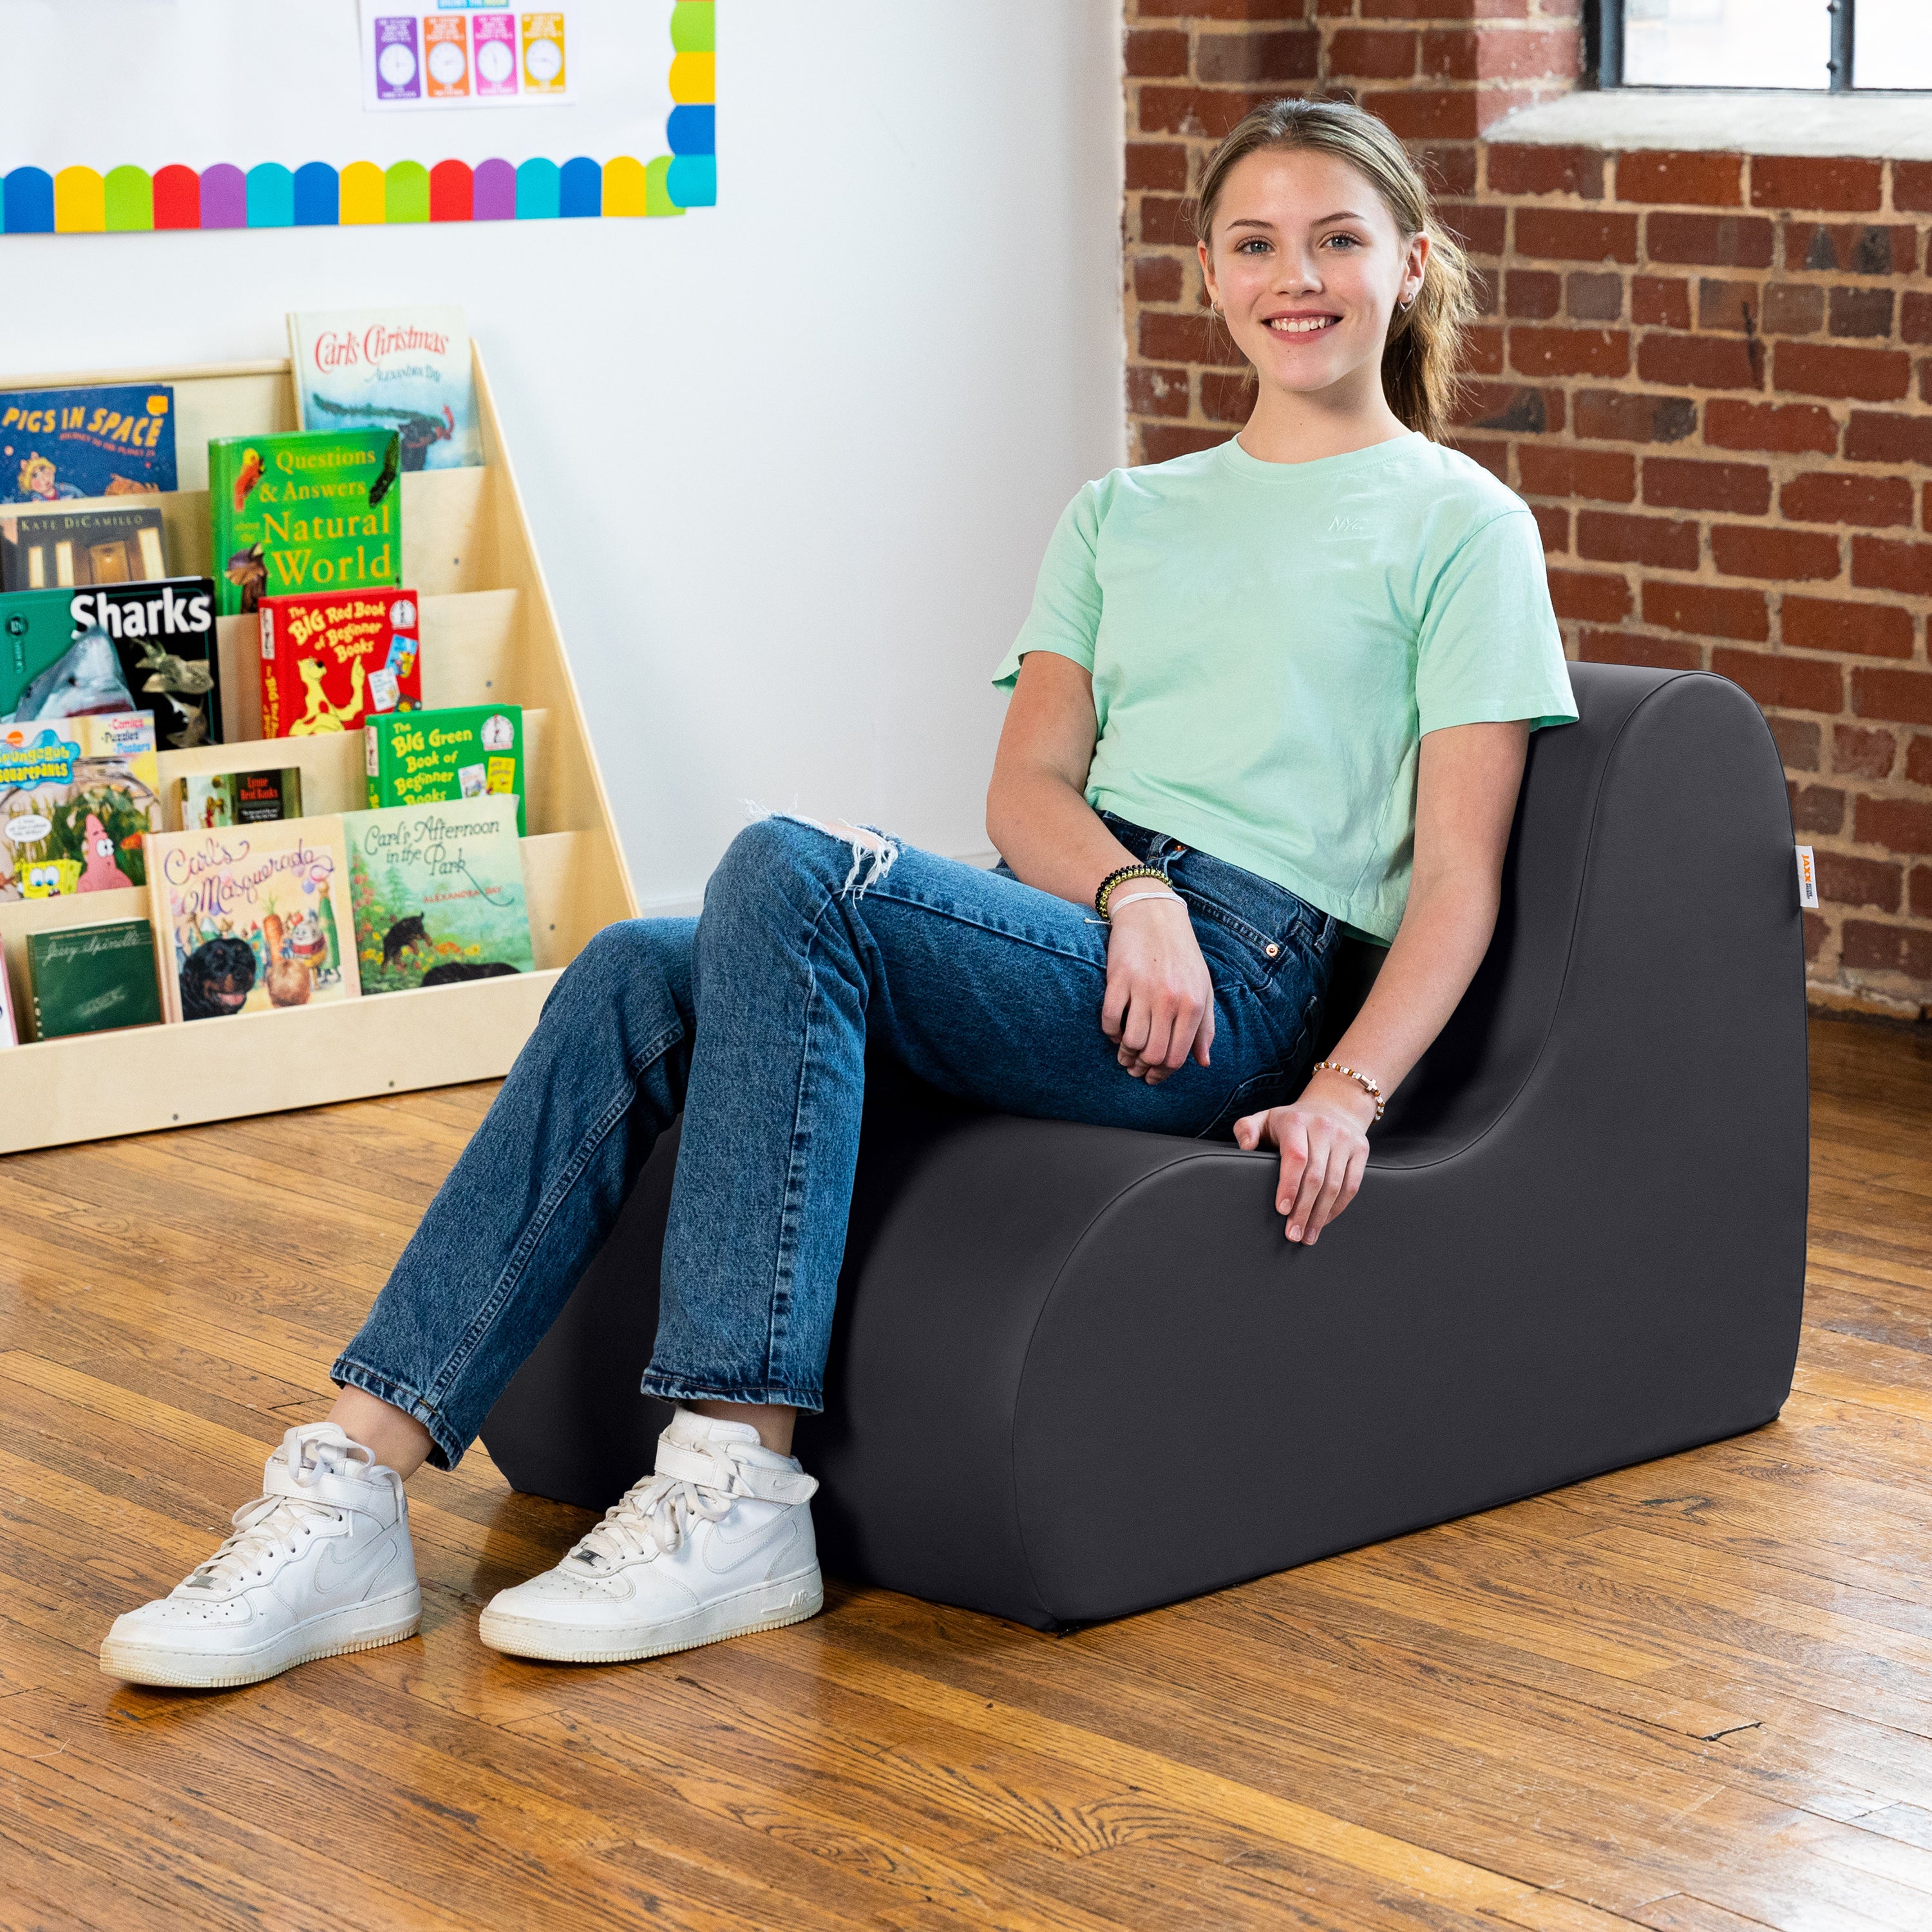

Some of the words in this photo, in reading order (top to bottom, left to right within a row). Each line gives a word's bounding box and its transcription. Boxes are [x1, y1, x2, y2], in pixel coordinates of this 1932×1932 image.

[314, 331, 359, 374] Carl's
[363, 323, 449, 366] Christmas
[2, 407, 55, 433] PIGS
[62, 406, 86, 430] IN
[87, 408, 164, 447] SPACE
[276, 446, 376, 475] Questions
[259, 483, 277, 502] &
[283, 481, 366, 501] Answers
[262, 505, 390, 544] Natural
[272, 544, 390, 585] World
[70, 587, 212, 640] Sharks
[288, 609, 327, 646] BIG
[325, 602, 353, 624] Red
[354, 601, 386, 618] Book
[314, 635, 325, 650] of
[325, 623, 383, 647] Beginner
[334, 638, 375, 663] Books
[391, 731, 425, 758] BIG
[428, 728, 473, 747] Green
[393, 723, 412, 734] The
[0, 746, 70, 764] pongeBob
[405, 751, 439, 773] Book
[443, 750, 458, 763] of
[394, 772, 453, 796] Beginner
[403, 788, 446, 806] Books
[365, 821, 411, 856] Carl's
[414, 815, 500, 842] Afternoon
[164, 837, 250, 886] Carl's
[386, 851, 399, 864] in
[401, 844, 422, 866] the
[181, 838, 334, 915] Masquerade
[790, 1589, 809, 1608] AIR
